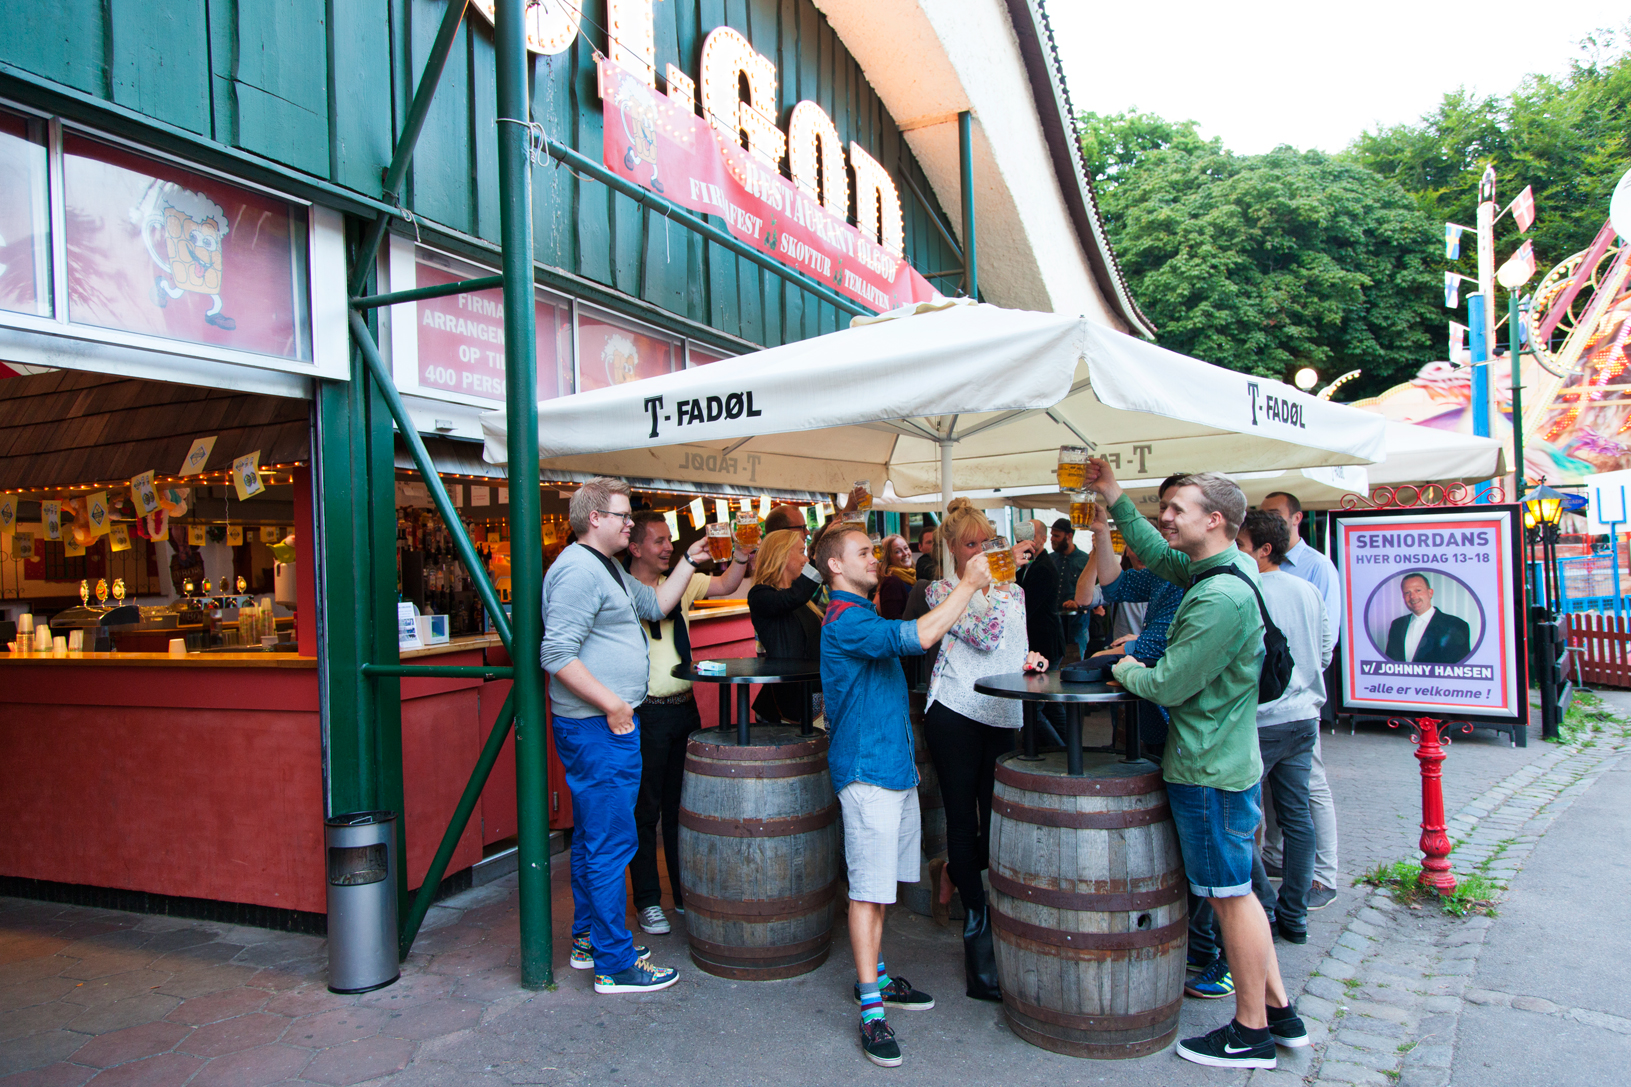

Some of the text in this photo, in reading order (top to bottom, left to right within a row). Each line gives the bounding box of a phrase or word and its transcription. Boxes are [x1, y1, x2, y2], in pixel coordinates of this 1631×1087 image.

[744, 158, 898, 285] RESTAURANT ØLGOD
[688, 176, 890, 311] FIRAFEST SKOVTUR TEMAAFTEN
[459, 344, 481, 364] OP
[425, 364, 457, 386] 400
[1355, 531, 1490, 549] SENIORDANS
[1355, 552, 1491, 564] HVER ONSDAG 13-18
[1362, 662, 1492, 678] v/ JOHNNY HANSEN
[1396, 686, 1412, 695] er
[1414, 686, 1482, 699] velkomne
